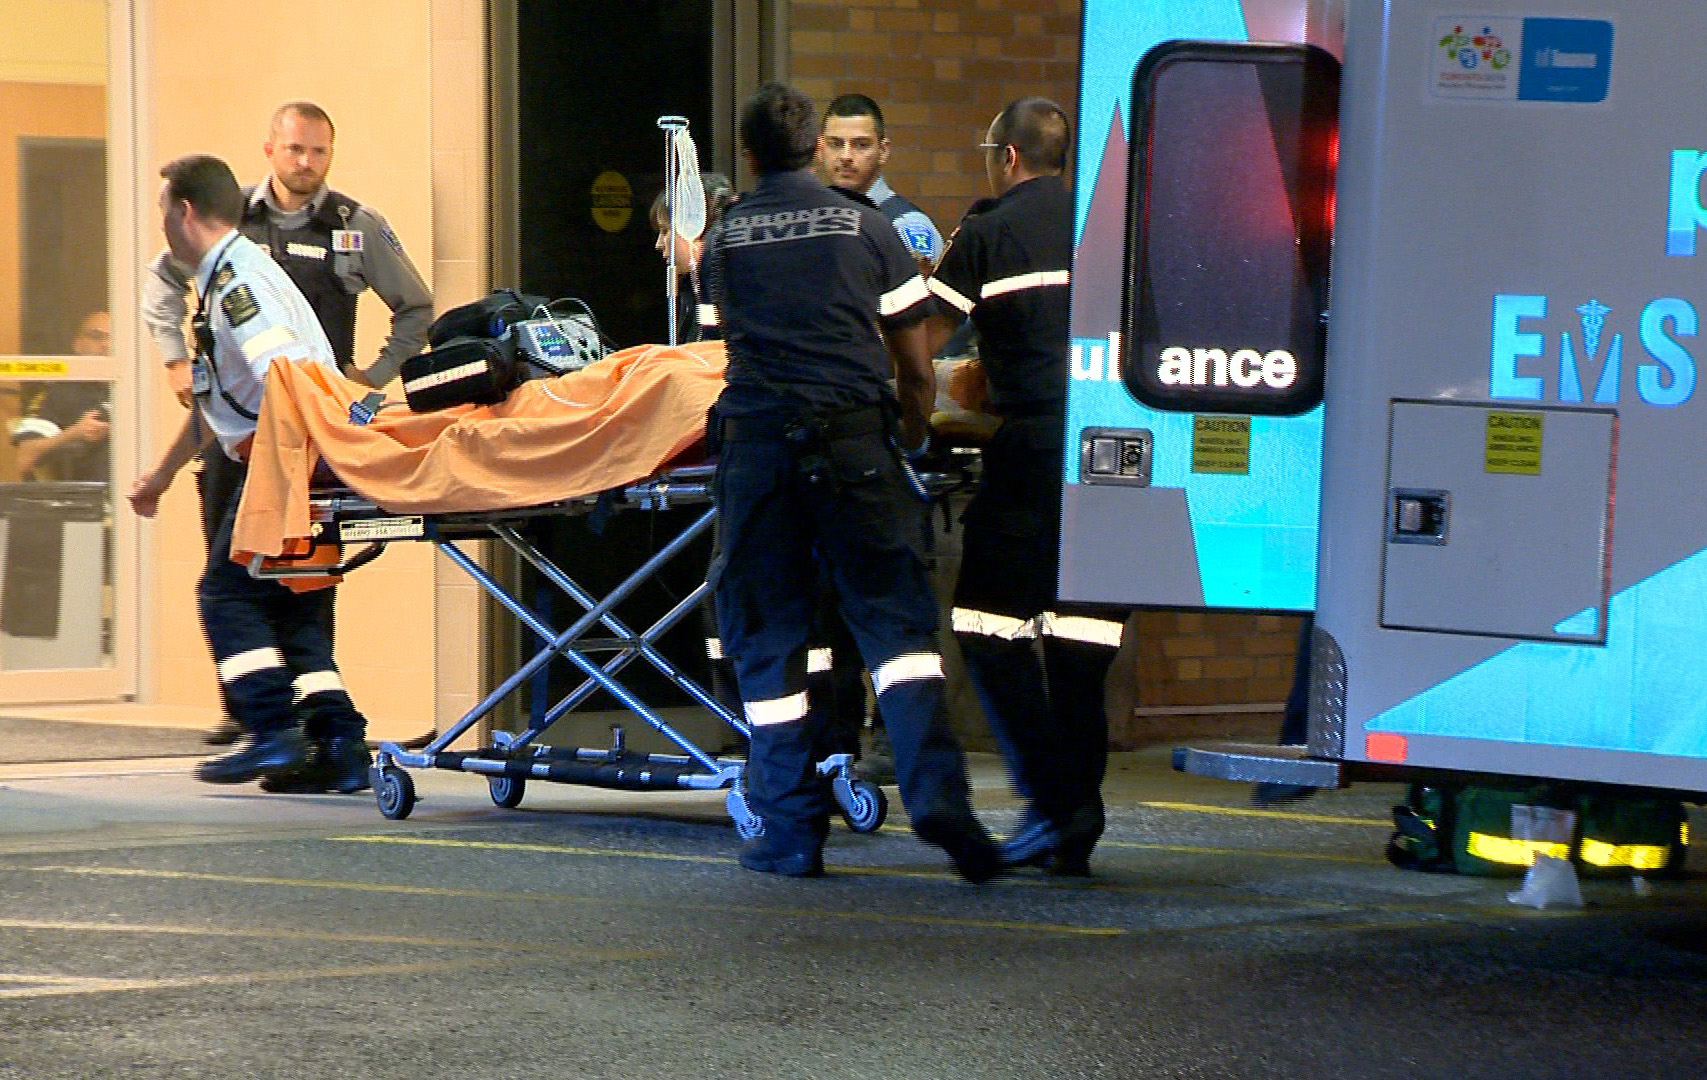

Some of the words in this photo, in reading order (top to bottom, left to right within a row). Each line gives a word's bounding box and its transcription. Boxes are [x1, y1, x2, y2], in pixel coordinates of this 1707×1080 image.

[722, 217, 860, 249] EMS
[1489, 294, 1699, 407] EMS
[1195, 419, 1250, 433] CAUTION
[1489, 415, 1541, 429] CAUTION
